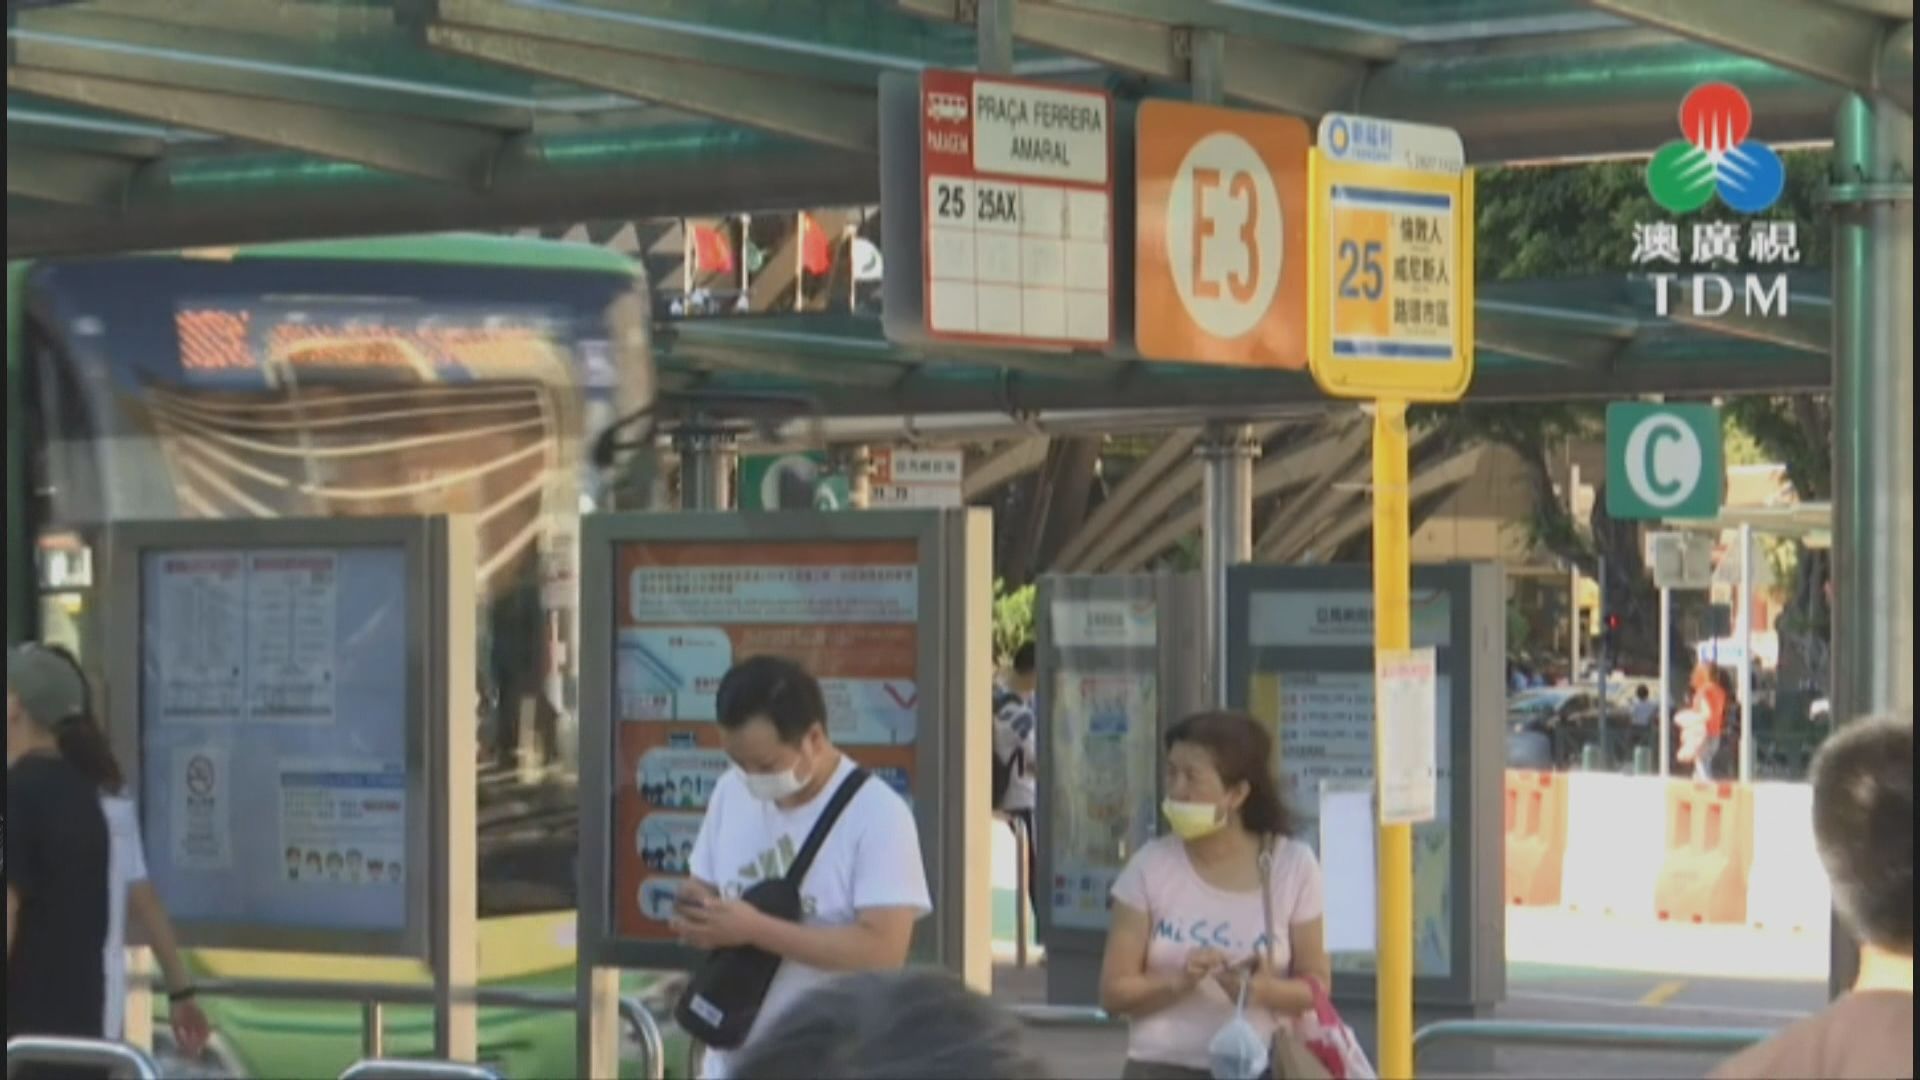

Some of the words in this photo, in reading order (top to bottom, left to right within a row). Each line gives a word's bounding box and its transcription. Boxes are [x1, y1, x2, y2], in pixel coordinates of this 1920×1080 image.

[977, 94, 1029, 130] PRAÇA
[1033, 101, 1103, 132] FERREIRA
[1009, 136, 1071, 166] AMARAL
[937, 184, 966, 218] 25
[977, 188, 1017, 222] 25AX
[1192, 168, 1260, 304] E3
[1338, 239, 1384, 303] 25
[1644, 423, 1682, 497] C
